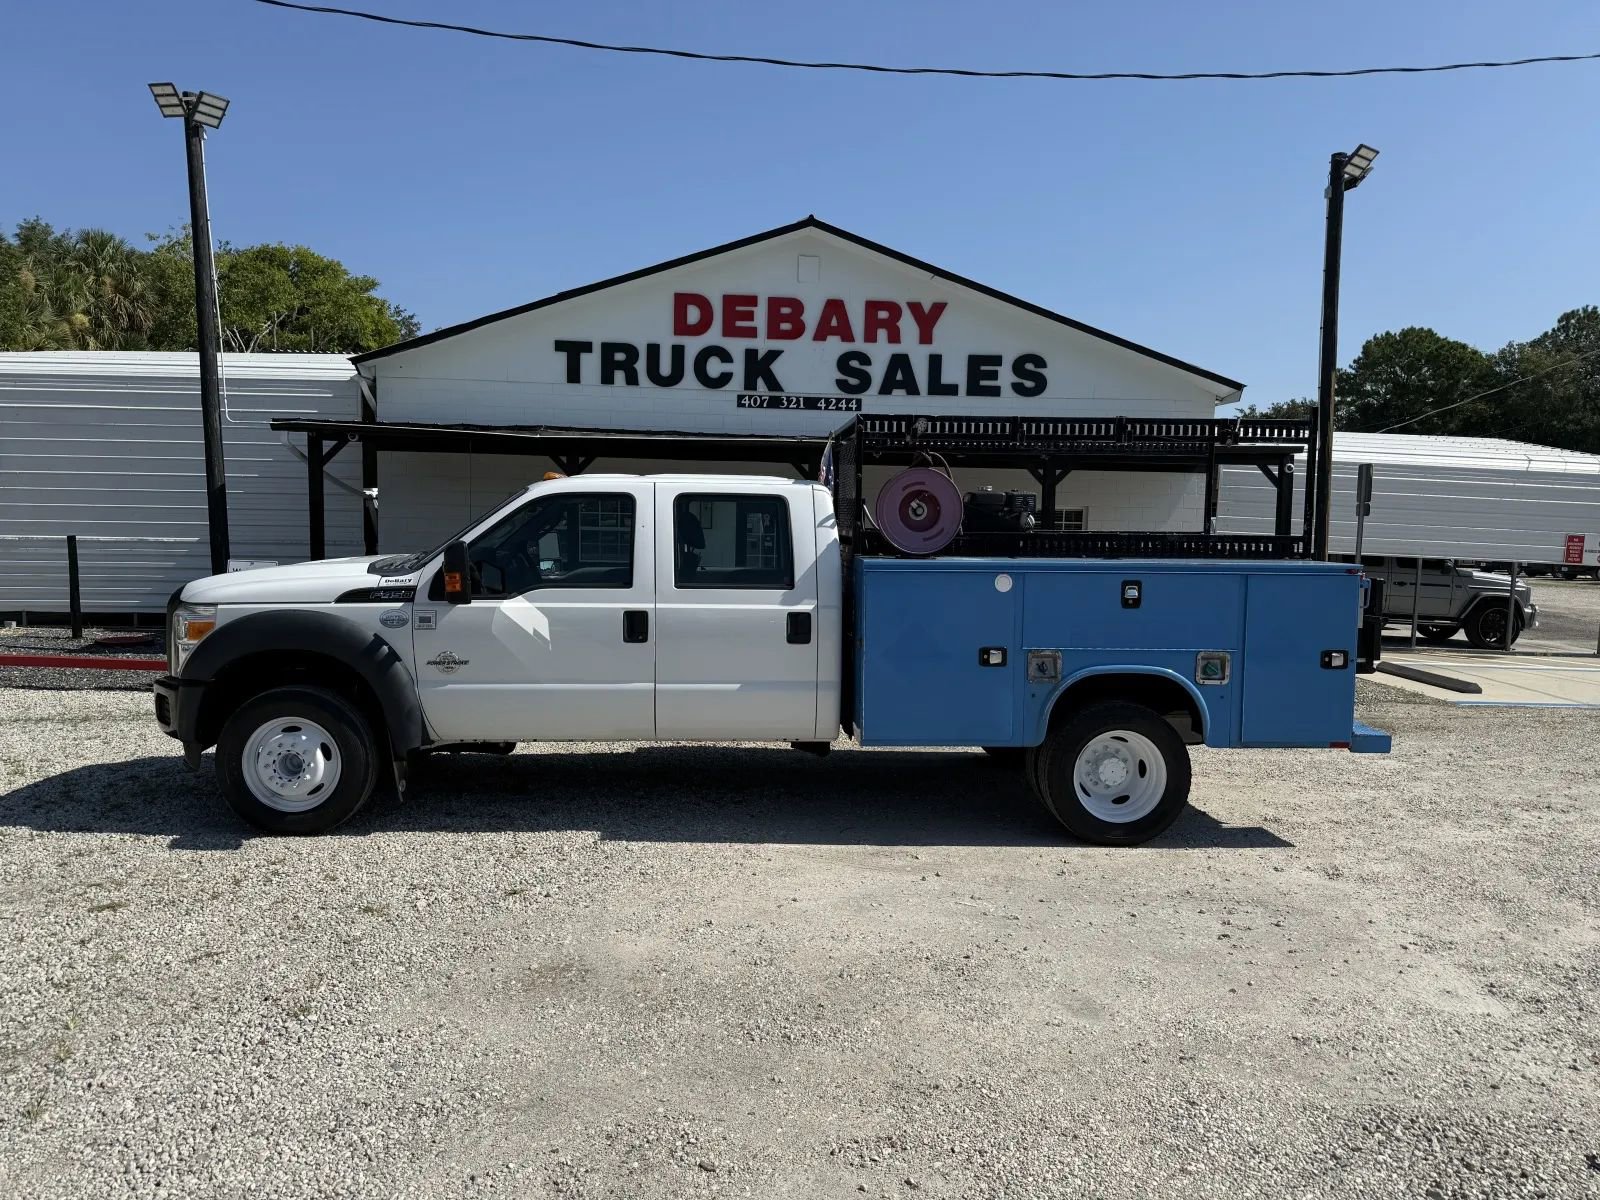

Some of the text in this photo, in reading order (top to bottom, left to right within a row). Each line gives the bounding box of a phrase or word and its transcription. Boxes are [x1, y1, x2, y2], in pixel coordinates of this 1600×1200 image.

[673, 292, 948, 345] DEBARY
[554, 339, 1048, 398] TRUCK SALES
[740, 395, 858, 411] 407 321 4244
